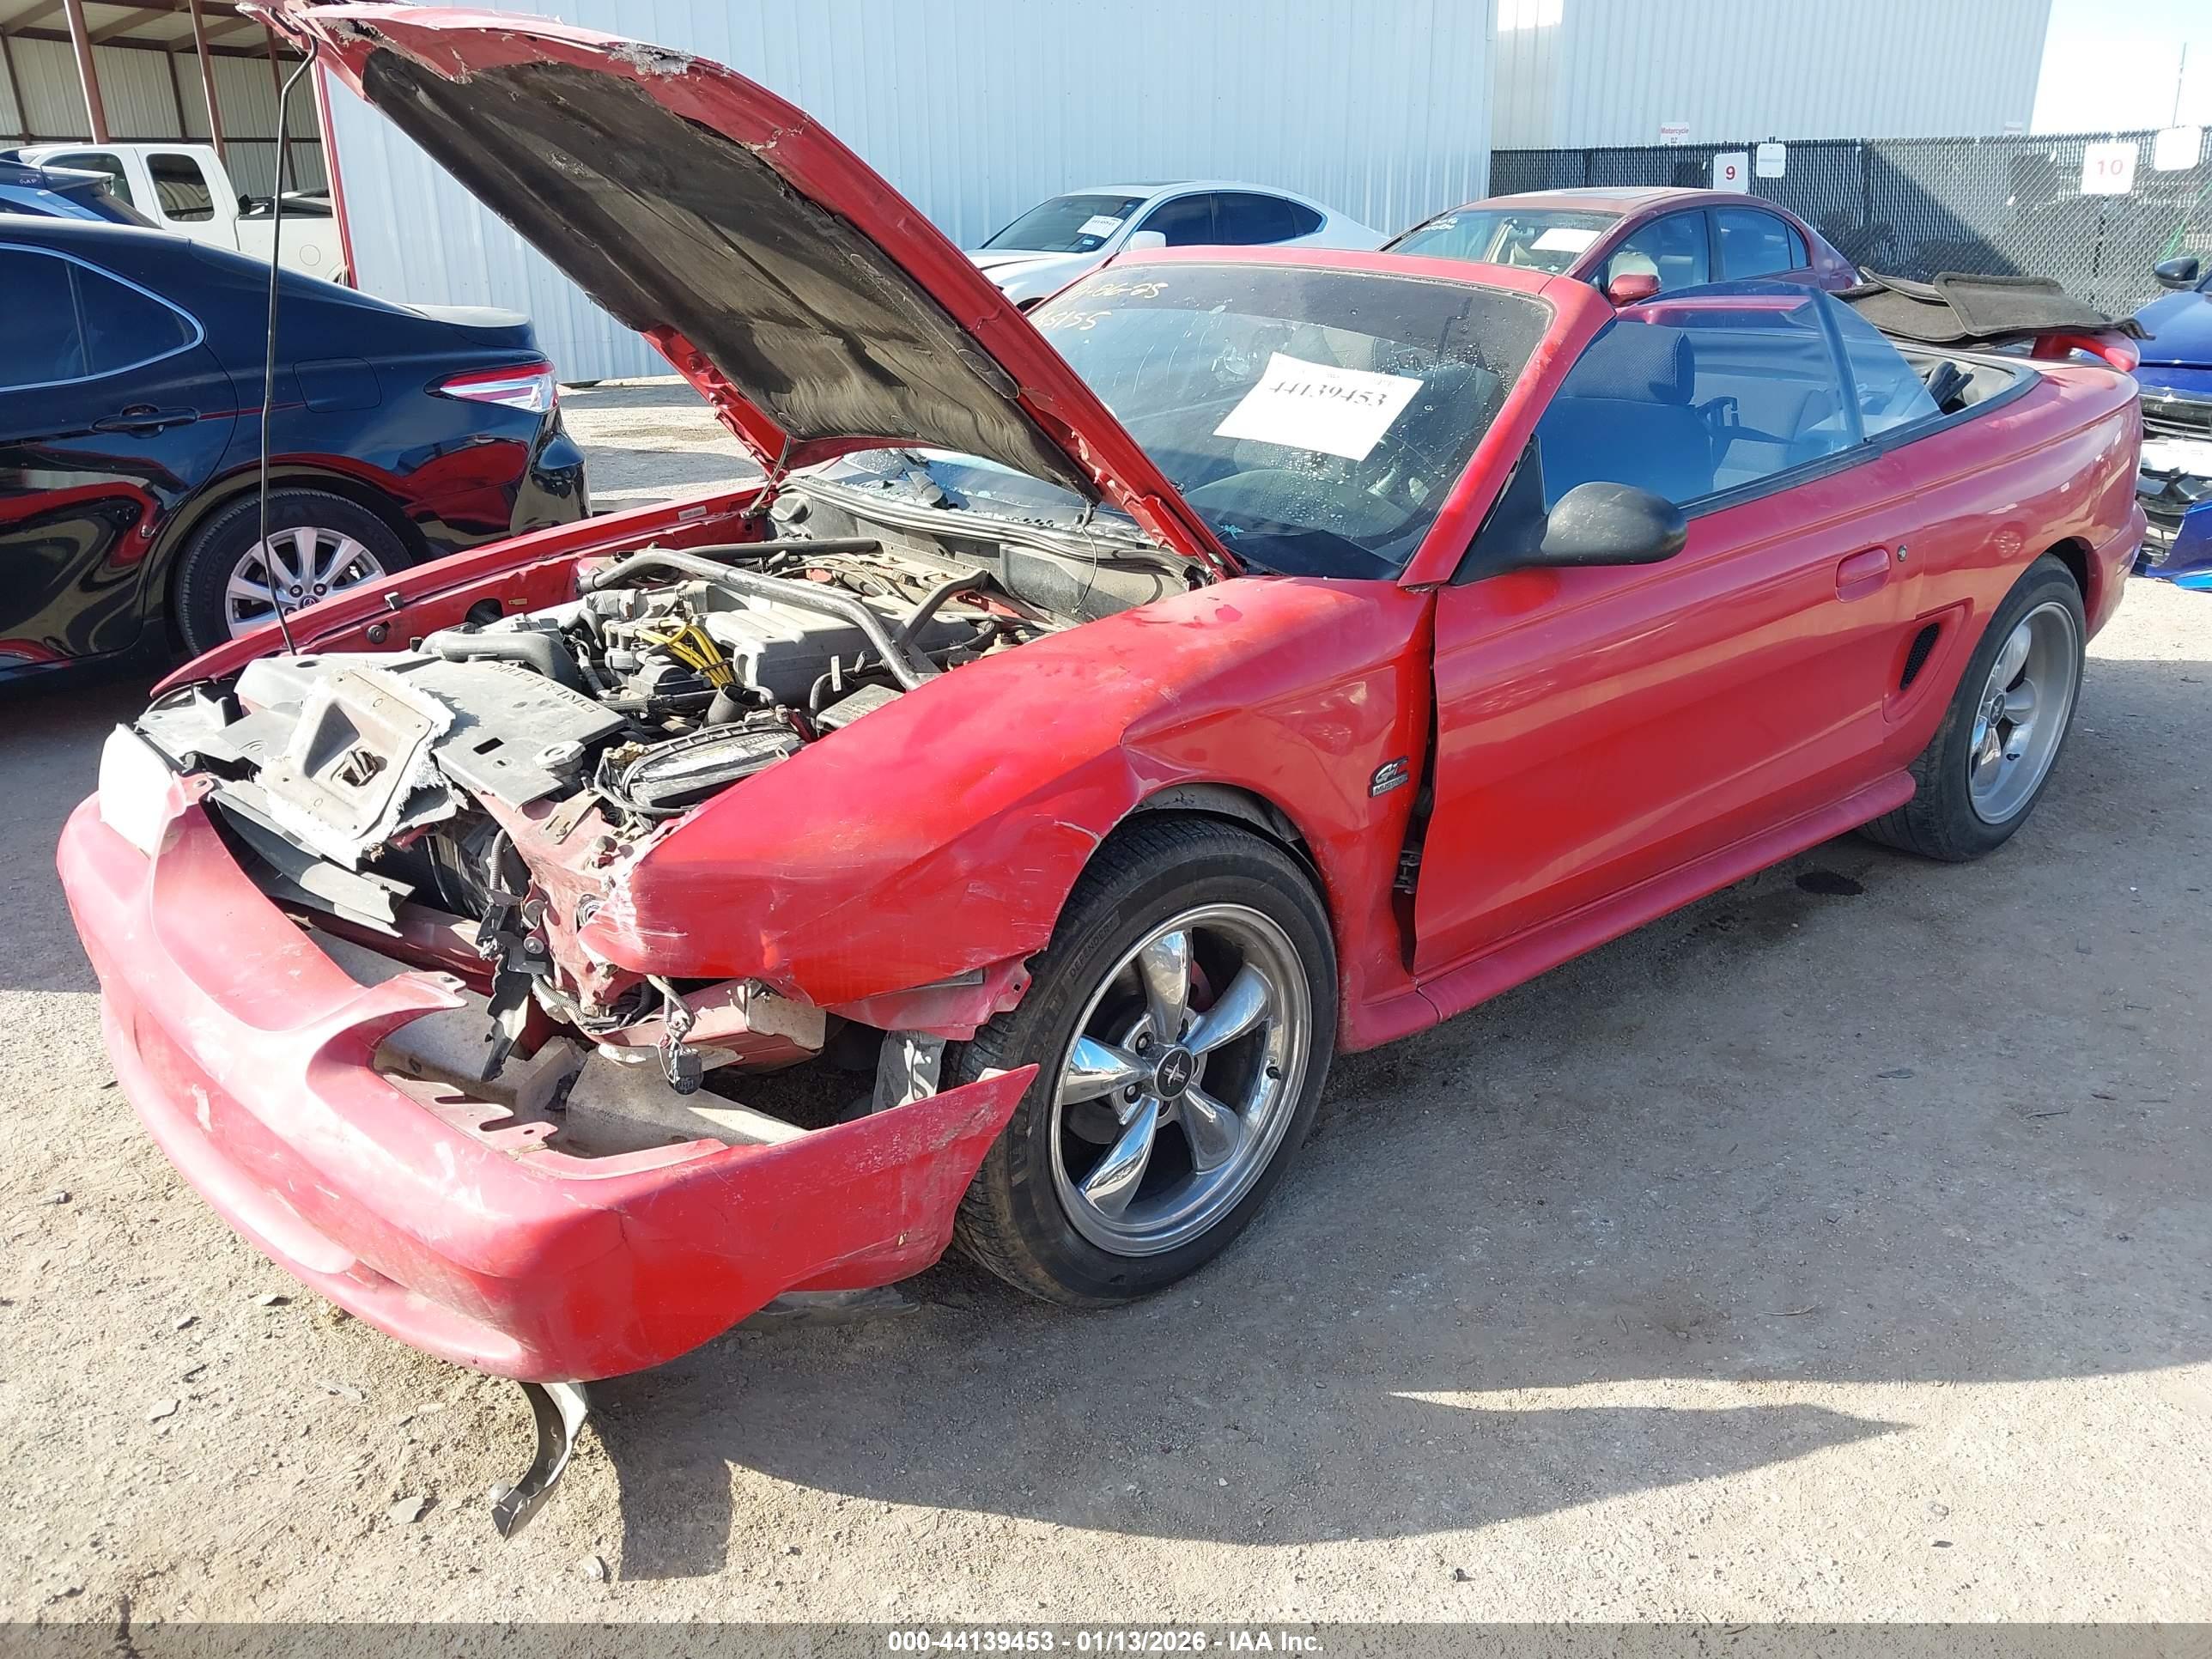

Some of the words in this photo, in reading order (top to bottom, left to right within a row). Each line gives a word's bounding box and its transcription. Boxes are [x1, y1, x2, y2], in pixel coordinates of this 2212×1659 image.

[1725, 166, 1735, 180] 9
[2096, 159, 2124, 175] 10
[1269, 380, 1389, 407] 44139453
